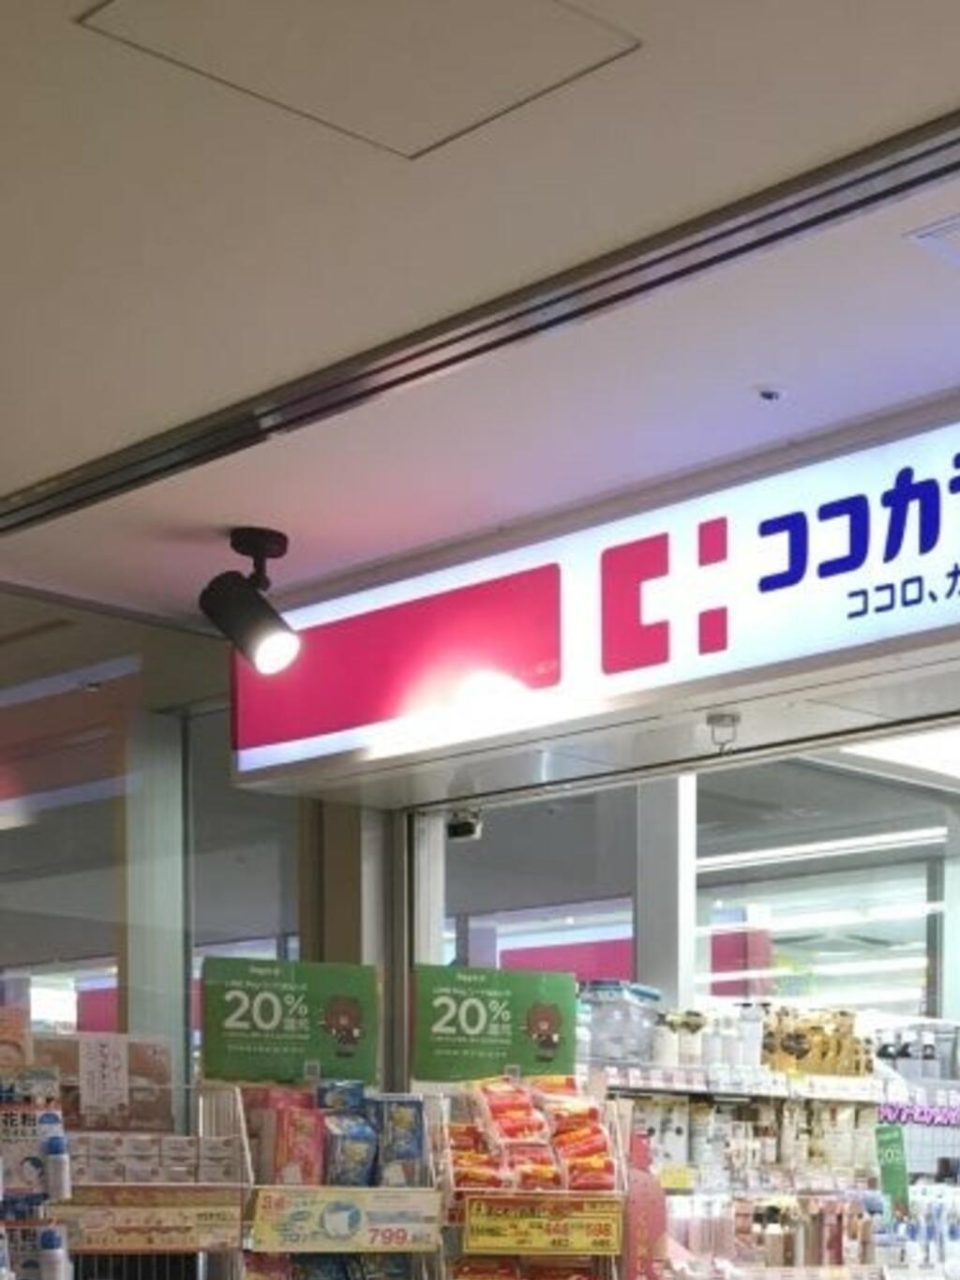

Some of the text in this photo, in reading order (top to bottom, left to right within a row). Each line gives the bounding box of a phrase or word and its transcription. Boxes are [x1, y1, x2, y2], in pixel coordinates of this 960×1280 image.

[223, 990, 309, 1030] 20%
[431, 995, 512, 1036] 20%
[367, 1228, 408, 1246] 799
